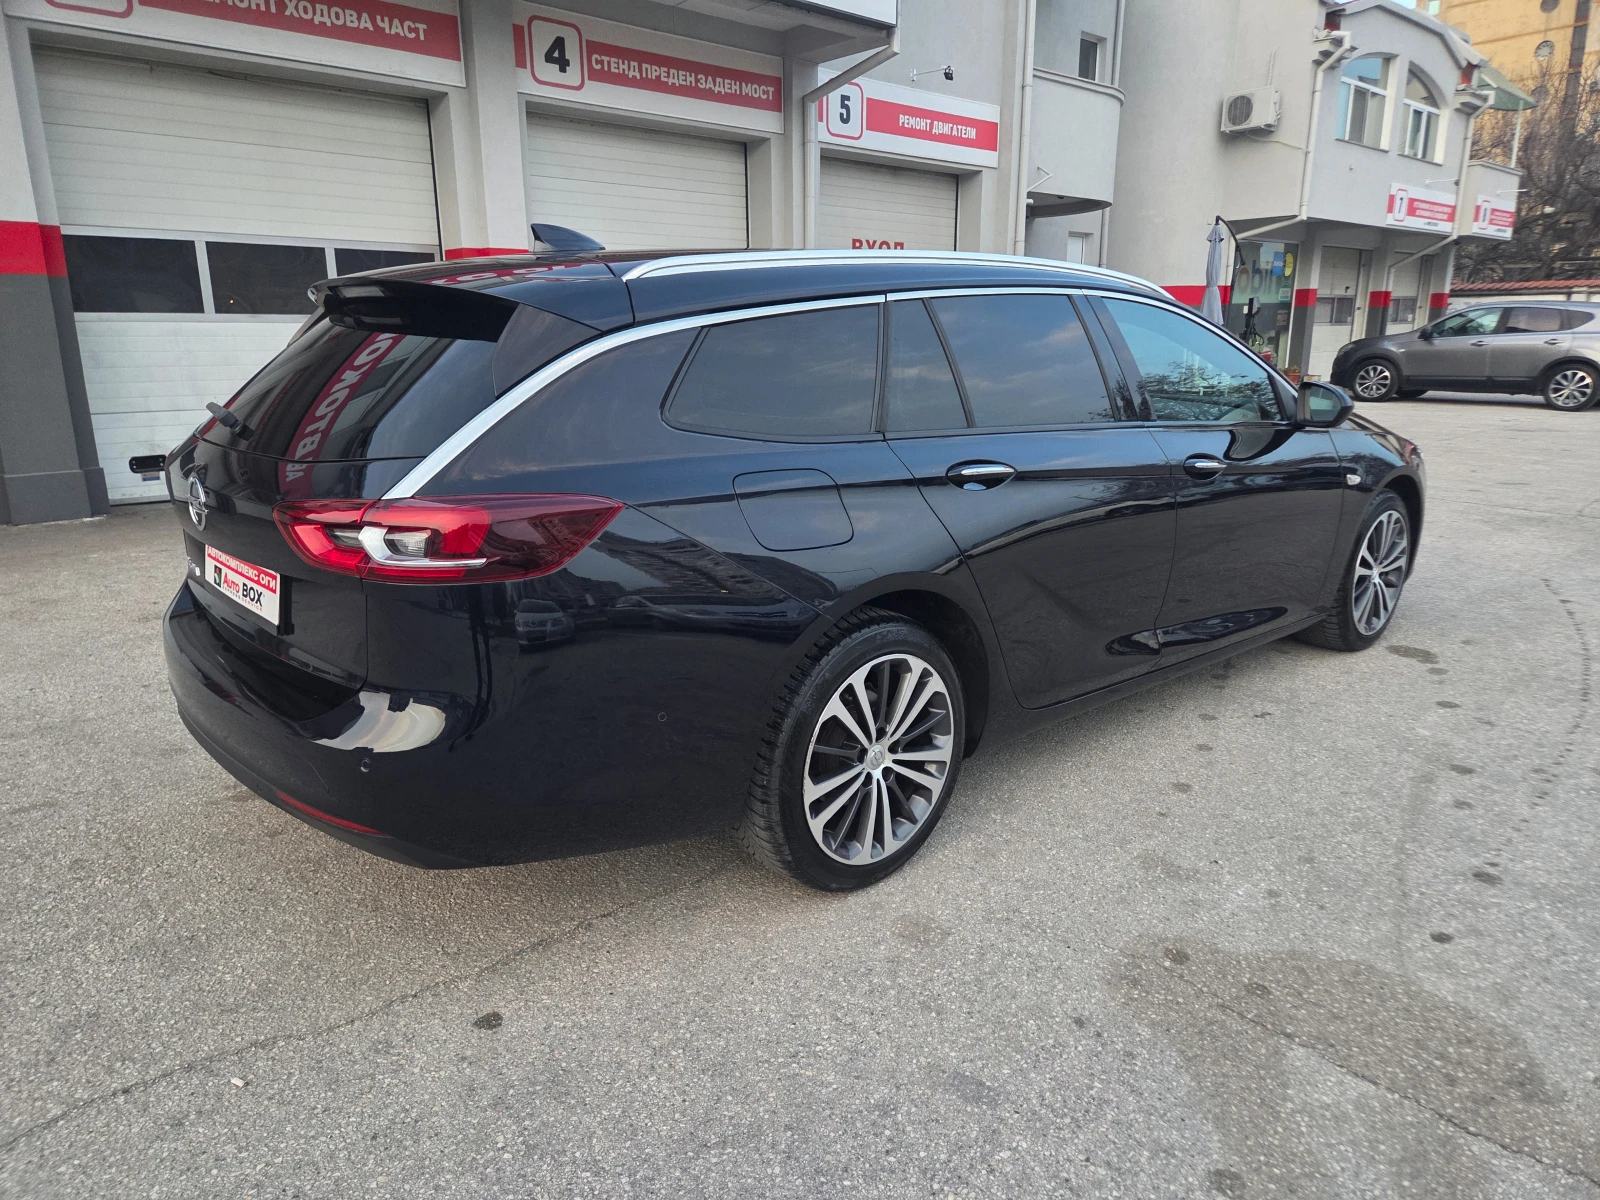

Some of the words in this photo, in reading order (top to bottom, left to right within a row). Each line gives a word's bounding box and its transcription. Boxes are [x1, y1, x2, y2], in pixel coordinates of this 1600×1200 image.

[284, 0, 374, 31] ХОДОВА
[376, 14, 427, 41] ЧАСТ
[544, 35, 571, 74] 4
[591, 53, 640, 80] СТЕНД
[642, 63, 696, 87] ПРЕДЕН
[697, 74, 740, 95] ЗАДЕН
[742, 81, 775, 100] МОСТ
[839, 93, 851, 125] 5
[899, 113, 932, 132] РЕМОНТ
[932, 120, 977, 140] ДВИГАТЕЛИ
[242, 581, 263, 608] BOX
[259, 573, 276, 591] ОГИ
